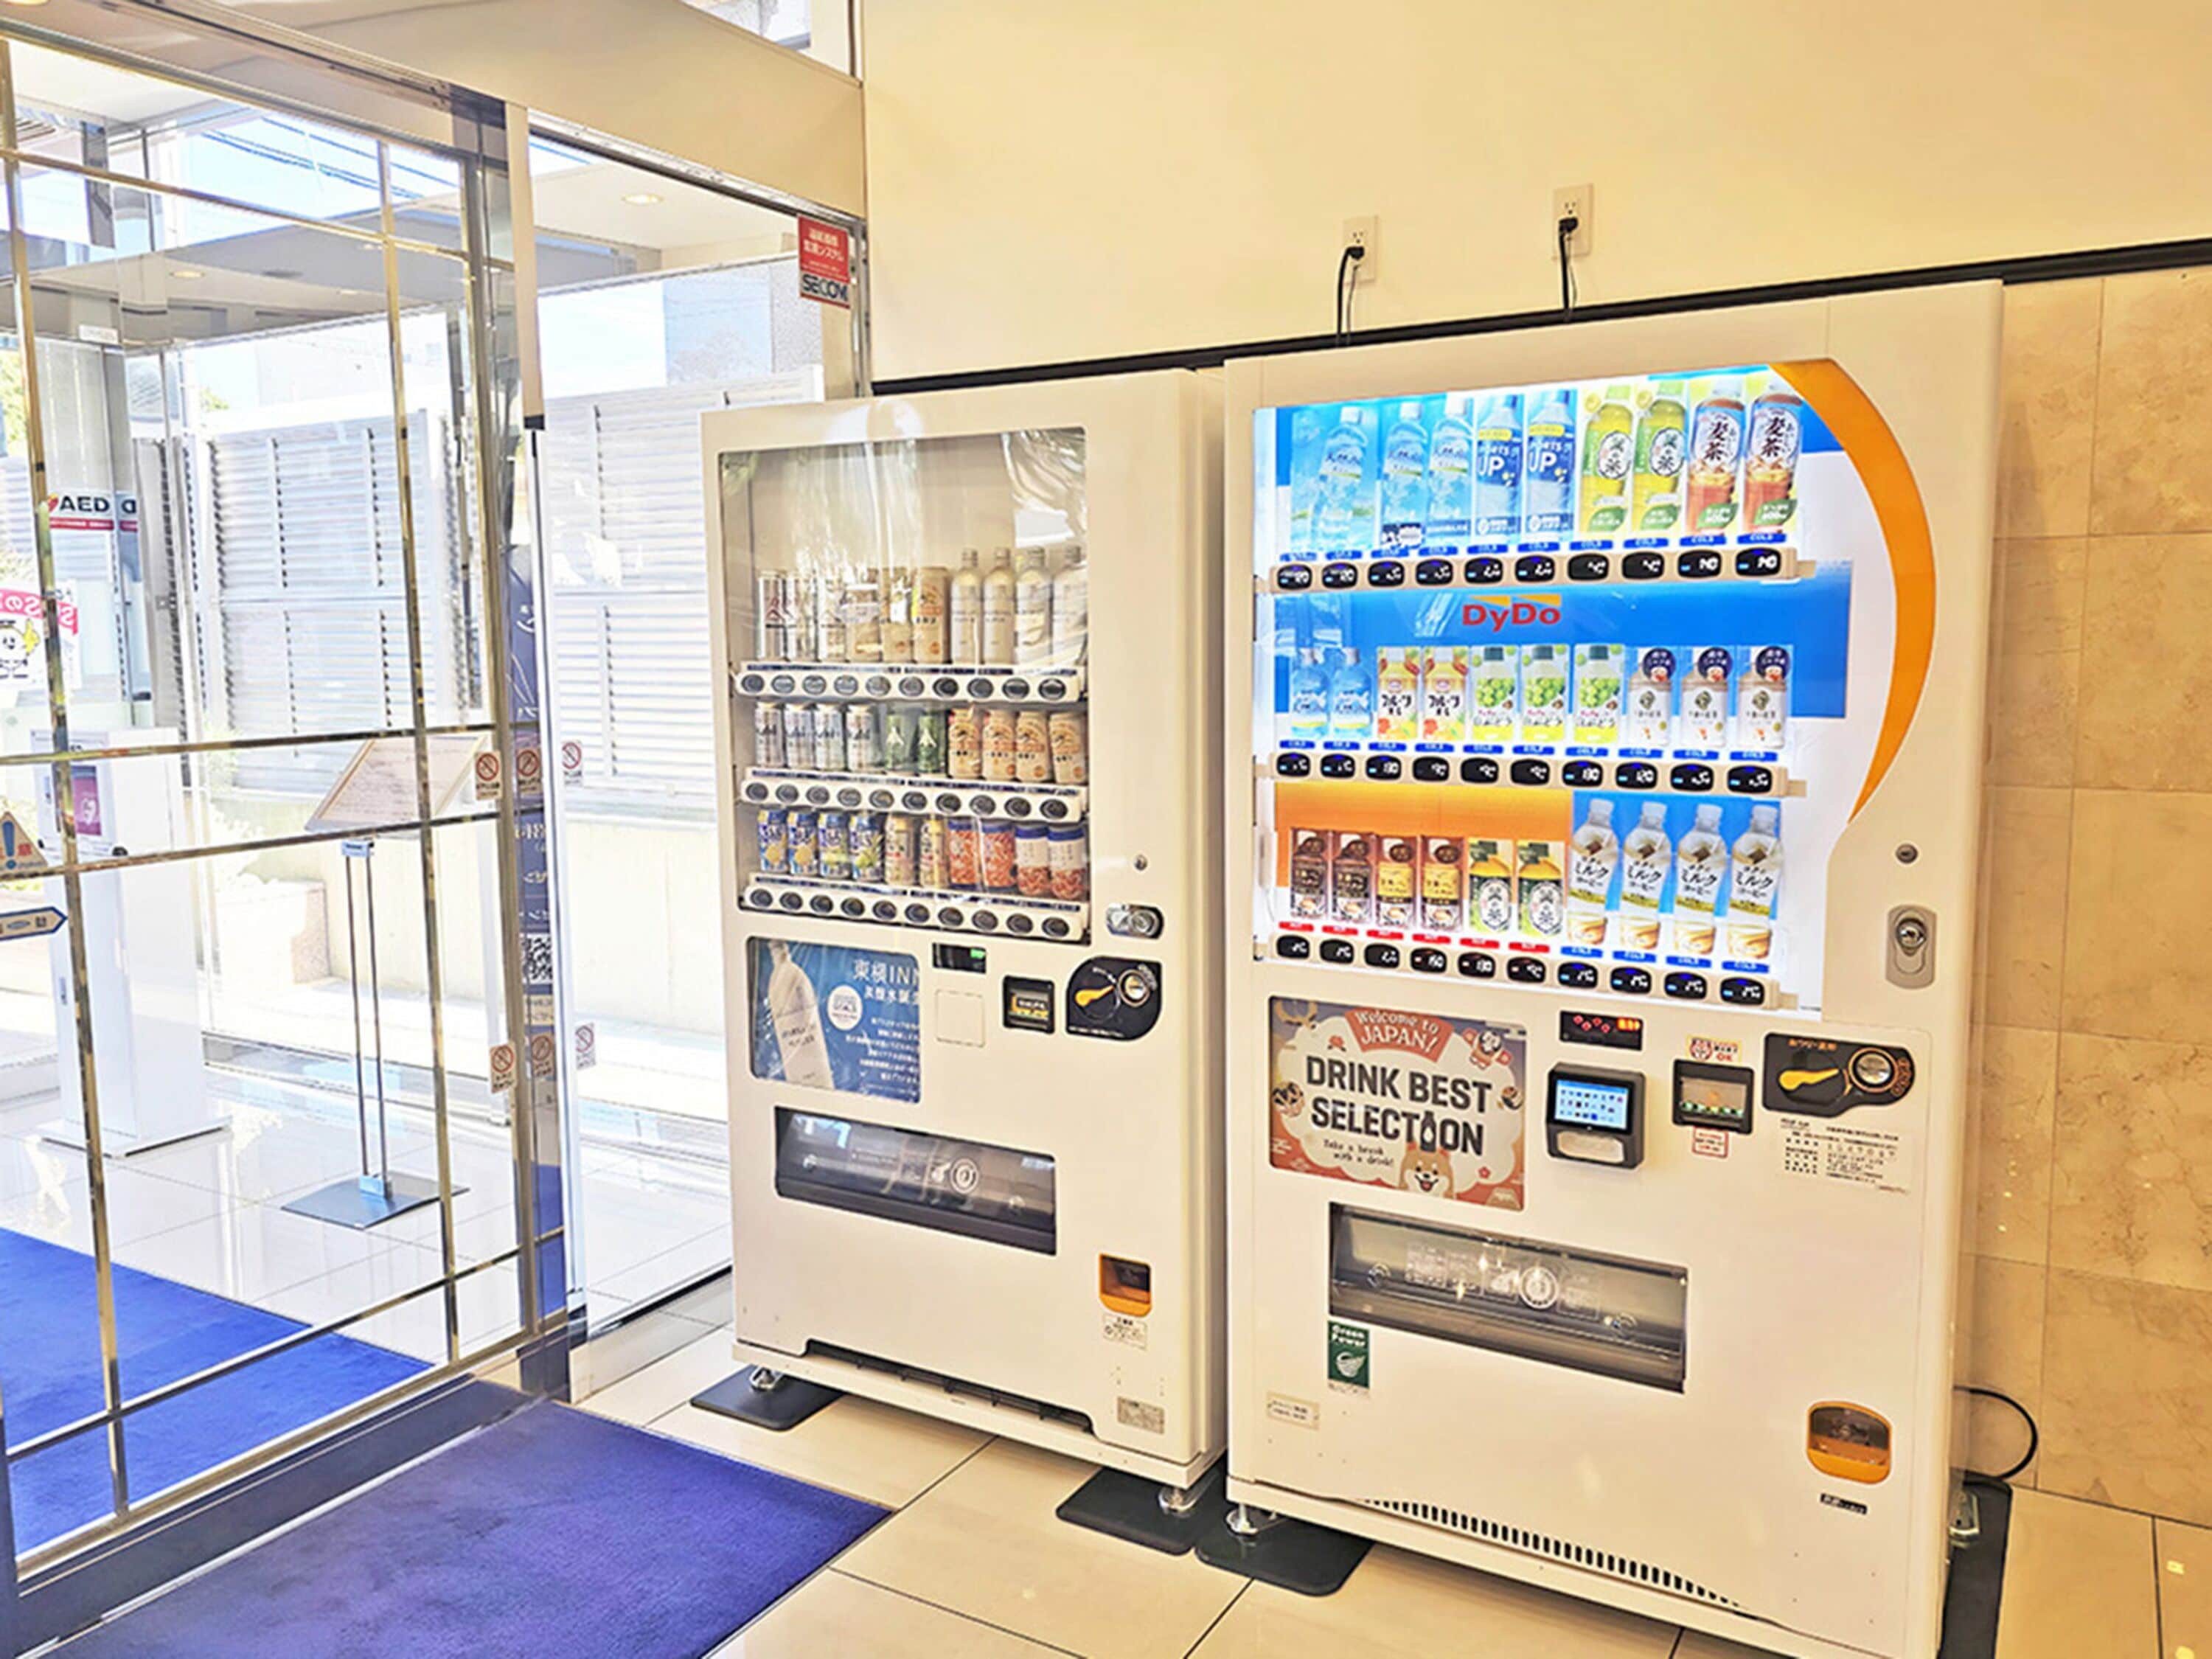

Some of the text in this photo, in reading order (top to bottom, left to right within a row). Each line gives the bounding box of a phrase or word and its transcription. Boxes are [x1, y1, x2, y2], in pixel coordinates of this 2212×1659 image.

[60, 495, 110, 512] AED
[1462, 602, 1561, 633] DyDo
[1575, 861, 1609, 879] ミルク
[1627, 865, 1662, 883] ミルク
[1682, 869, 1717, 886] ミルク
[1736, 872, 1773, 889] ミルク
[1354, 1009, 1439, 1035] Welcome to
[1360, 1024, 1439, 1053] JAPAN!
[1307, 1055, 1492, 1113] DRINK BEST
[1311, 1096, 1484, 1157] SELECTION
[1332, 1325, 1366, 1338] Green
[1332, 1333, 1366, 1347] Power
